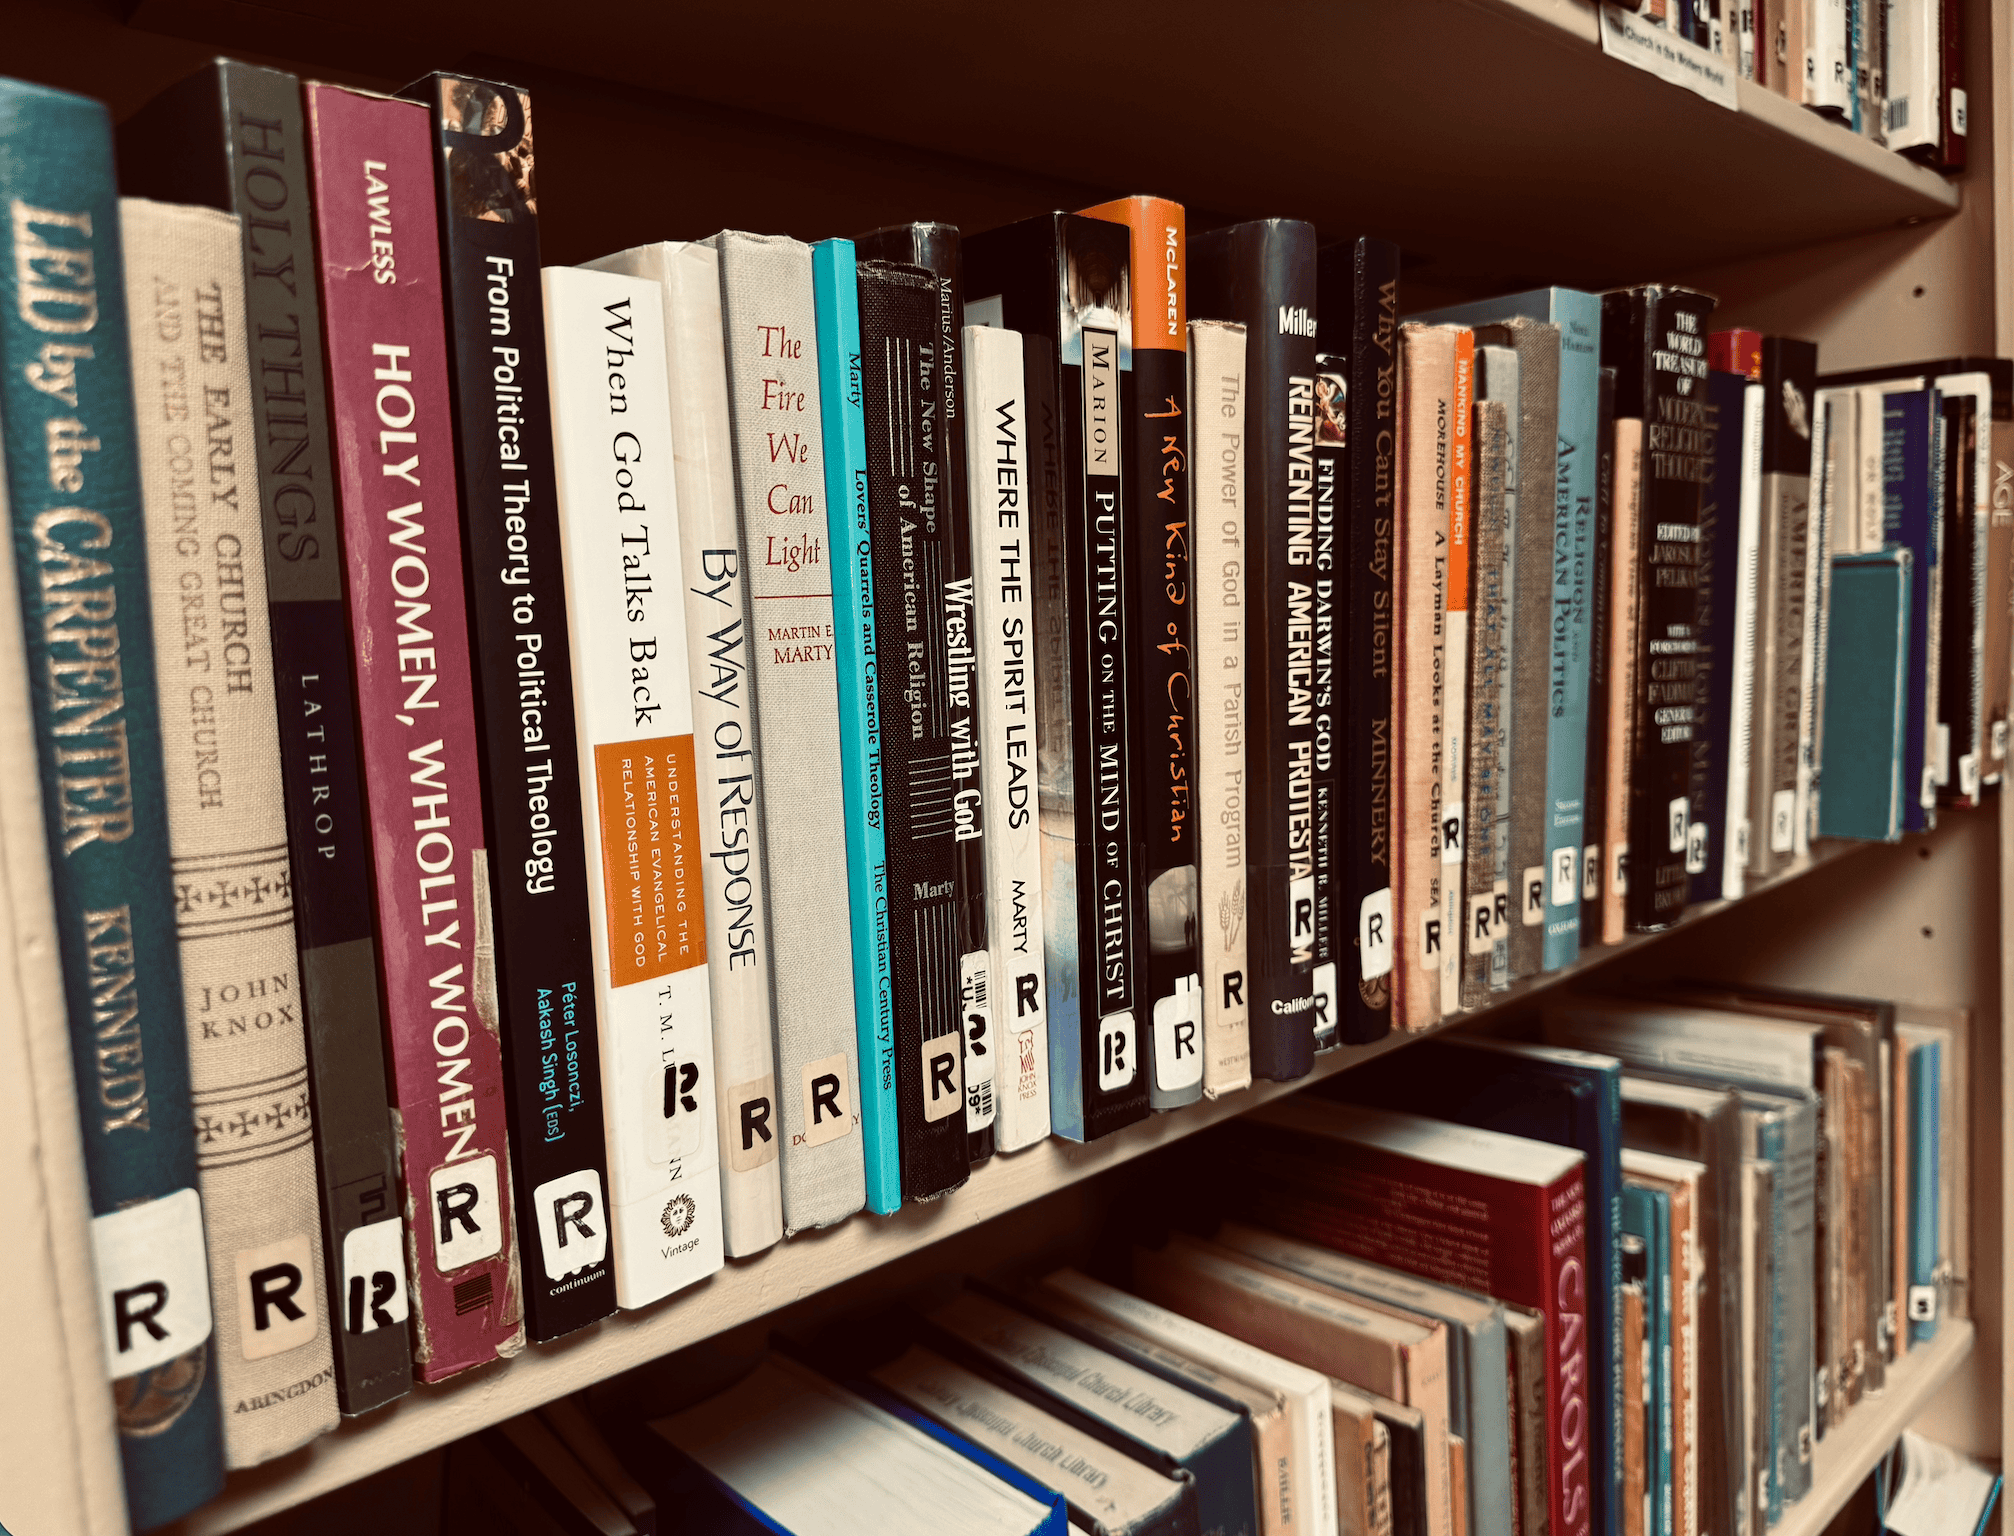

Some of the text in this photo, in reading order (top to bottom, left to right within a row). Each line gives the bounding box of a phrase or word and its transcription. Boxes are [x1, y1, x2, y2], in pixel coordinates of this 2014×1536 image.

[1834, 60, 1845, 84] R
[364, 160, 397, 285] LAWLESS
[239, 112, 320, 562] HOLY THINGS
[757, 325, 802, 359] The
[1372, 279, 1396, 356] Why
[761, 378, 805, 412] Fire
[847, 352, 862, 409] Marty
[1377, 361, 1394, 420] You
[766, 432, 808, 464] We
[919, 342, 940, 534] The New Shape
[1454, 359, 1468, 546] MANKIND MY CHURCH
[195, 281, 254, 695] THE EARLY CHURCH
[603, 297, 662, 728] When God Talks Back
[767, 484, 814, 515] Can
[1317, 459, 1335, 572] FINDING
[1992, 459, 2014, 528] AGE
[155, 276, 223, 810] AND THE COMING GREAT CHURCH
[485, 255, 559, 895] From Political Theory to Political Theology
[690, 548, 739, 608] By
[765, 533, 821, 572] Light
[856, 540, 874, 619] Quarrels
[940, 277, 983, 842] Marius/Anderson Wrestling with God
[1164, 521, 1188, 605] Kind
[1287, 375, 1314, 727] REINVENTING AMERICAN
[1369, 518, 1391, 581] Stay
[1552, 433, 1577, 718] AMERICAN POLITICS
[1573, 496, 1592, 624] RELIGION
[768, 625, 821, 641] MARTIN
[862, 623, 875, 656] and
[898, 484, 928, 741] of American Religion
[1156, 622, 1191, 669] of
[1220, 372, 1242, 869] The Power of God in a Parish Program
[1373, 590, 1390, 679] Silent
[1430, 399, 1447, 858] MOREHOUSE A Layman Looks at the Church
[11, 199, 150, 1135] LED by the CARPENTER KENNEDY
[774, 643, 833, 664] MARTY
[995, 399, 1029, 953] WHERE THE SPIRIT LEADS MARTY
[1092, 343, 1125, 1000] MARION PUTTING ON THE MIND OF CHRIST
[864, 660, 879, 745] Casserole
[301, 674, 336, 860] LATHROP
[372, 343, 480, 1164] HOLY WOMEN, WHOLLY WOMEN
[1167, 671, 1190, 842] Christian
[1315, 713, 1334, 771] GOD
[867, 749, 882, 830] Theology
[1371, 718, 1387, 867] MINNERY
[621, 758, 646, 968] RELATIONSHIP WITH GOD
[644, 755, 668, 963] AMERICAN EVANGELICAL
[667, 753, 689, 955] UNDERSTANDING THE
[1442, 818, 1459, 849] R
[1559, 855, 1571, 883] R
[1586, 857, 1595, 885] R
[874, 861, 887, 893] The
[913, 880, 955, 900] Marty
[1494, 893, 1507, 925] R
[1529, 880, 1542, 910] R
[875, 896, 891, 973] Christian
[1368, 912, 1383, 947] R
[1426, 920, 1440, 953] R
[1475, 906, 1490, 938] R
[537, 988, 561, 1103] Aakash Singh
[561, 982, 585, 1112] Péter Losonczi,
[878, 976, 894, 1043] Century
[1315, 991, 1328, 1028] R
[882, 1046, 893, 1091] Press
[549, 1267, 606, 1296] continuum
[661, 1237, 700, 1260] Vintage
[234, 1365, 334, 1413] ABINGDON
[1557, 1256, 1587, 1526] CAROLS
